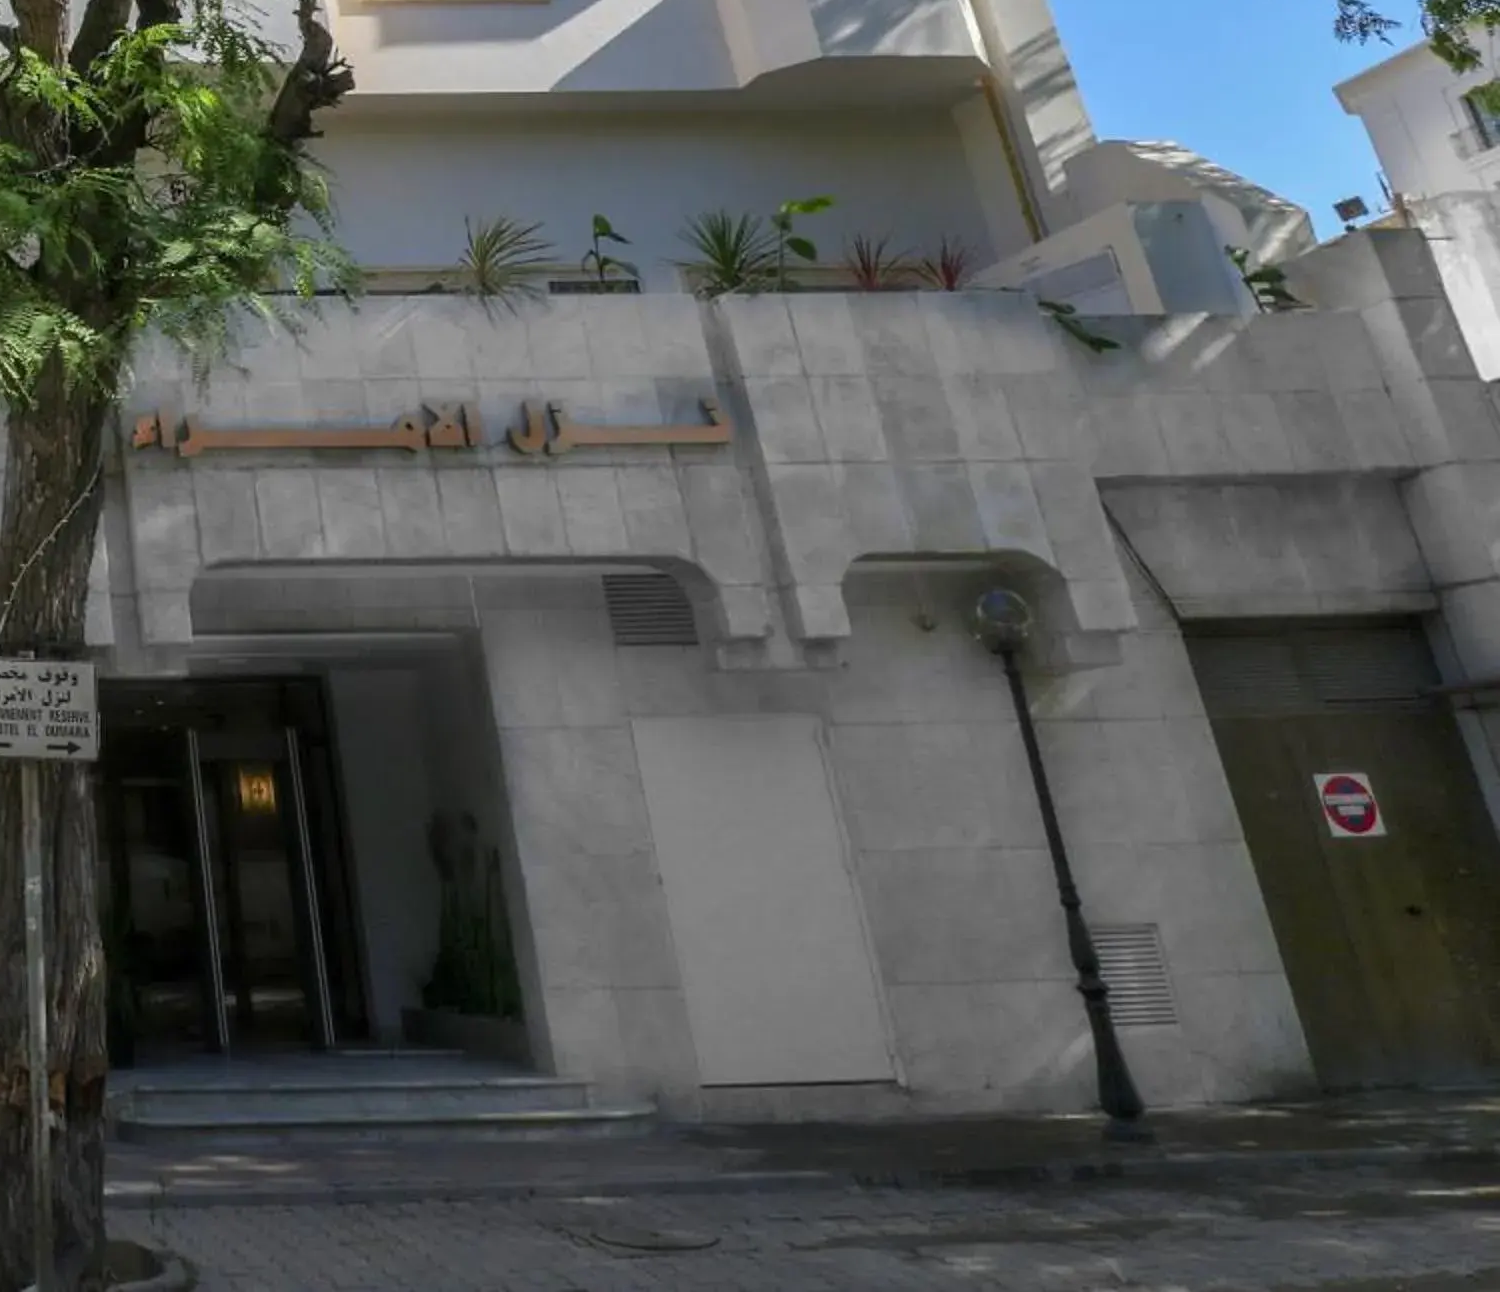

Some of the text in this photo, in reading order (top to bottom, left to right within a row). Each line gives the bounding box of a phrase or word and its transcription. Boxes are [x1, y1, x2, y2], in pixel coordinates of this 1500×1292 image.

[37, 669, 79, 686] وقوف
[41, 689, 71, 708] لنزل
[27, 723, 39, 737] EL
[45, 723, 91, 738] OUMARA
